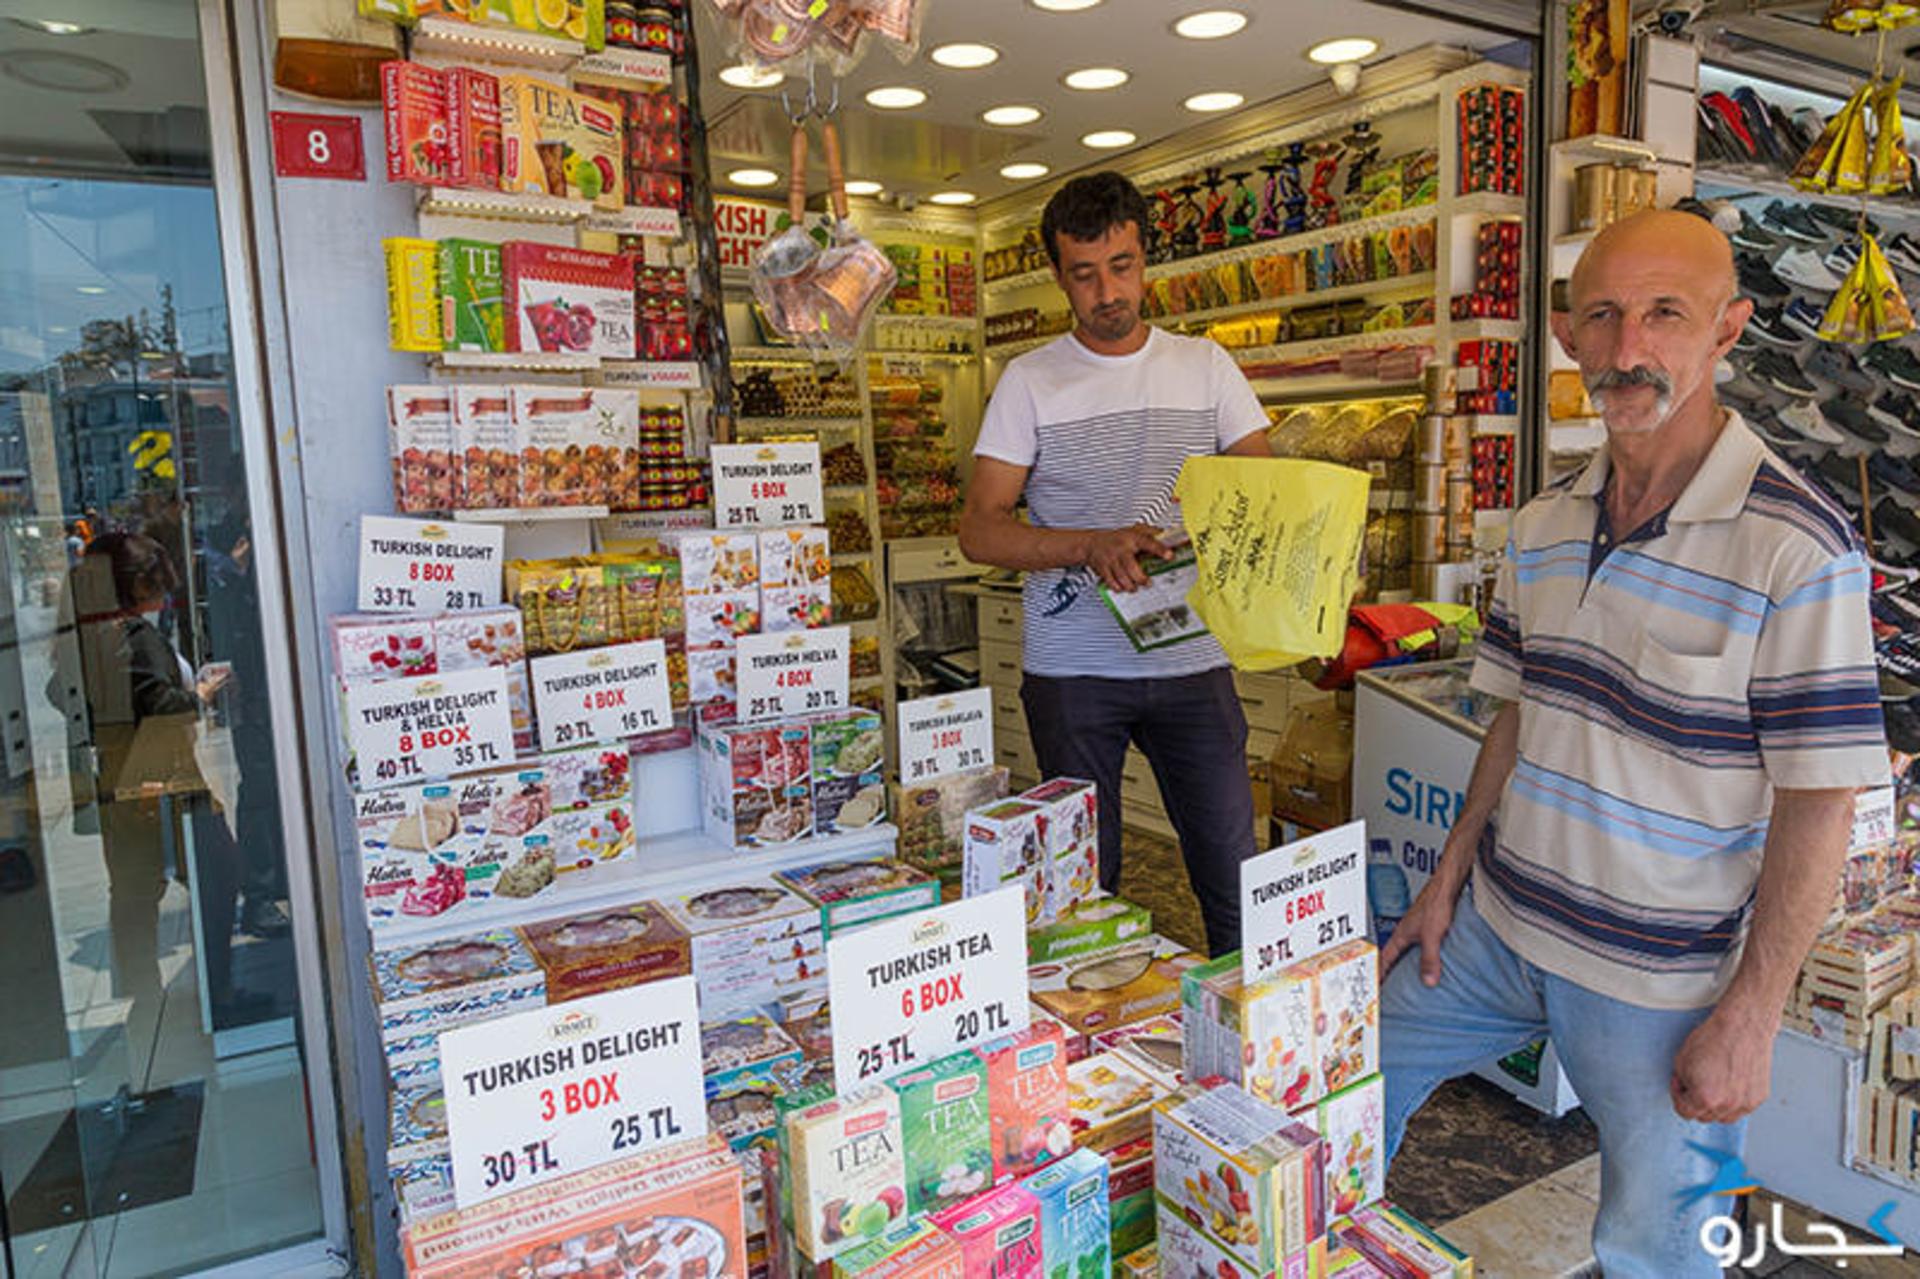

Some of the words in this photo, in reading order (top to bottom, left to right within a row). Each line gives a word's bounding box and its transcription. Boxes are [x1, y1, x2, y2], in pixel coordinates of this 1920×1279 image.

[527, 83, 580, 126] TEA
[308, 129, 331, 163] 8
[600, 320, 631, 339] TEA
[721, 465, 768, 478] TURKISH
[770, 462, 813, 476] DELIGHT
[762, 481, 787, 499] BOX
[745, 506, 760, 523] TL
[781, 505, 796, 521] 22
[798, 504, 813, 519] TL
[371, 539, 432, 557] TURKISH
[436, 544, 494, 560] DELIGHT
[409, 562, 419, 581] 8
[423, 563, 455, 582] BOX
[374, 587, 393, 606] 33
[397, 588, 416, 607] TL
[446, 590, 463, 609] 28
[467, 591, 483, 609] TL
[751, 652, 799, 669] TURKISH
[801, 648, 838, 664] HELVA
[544, 672, 601, 693] TURKISH
[604, 662, 658, 684] DELIGHT
[776, 671, 785, 688] 4
[787, 669, 812, 688] BOX
[361, 697, 431, 724] TURKISH
[434, 690, 498, 712] DELIGHT
[583, 694, 592, 710] 4
[595, 688, 626, 710] BOX
[750, 698, 765, 716] 25
[768, 696, 783, 713] TL
[806, 691, 821, 709] 20
[823, 690, 838, 706] TL
[399, 735, 413, 753] 8
[421, 725, 472, 749] BOX
[400, 718, 412, 733] &
[416, 711, 467, 730] HELVA
[554, 723, 572, 743] 20
[575, 721, 594, 739] TL
[641, 709, 659, 727] TL
[376, 758, 397, 780] 40
[400, 755, 423, 776] TL
[454, 745, 475, 767] 35
[478, 742, 499, 762] TL
[360, 799, 406, 816] Halva
[367, 866, 413, 884] Halva
[1403, 840, 1442, 876] Col
[1252, 871, 1305, 905] TURKISH
[1307, 852, 1357, 885] DELIGHT
[1285, 901, 1294, 925] 6
[1297, 889, 1326, 920] BOX
[1277, 937, 1294, 961] TL
[1317, 920, 1335, 945] 25
[1337, 913, 1354, 937] TL
[867, 944, 951, 990] TURKISH
[956, 932, 993, 960] TEA
[902, 988, 915, 1018] 6
[920, 973, 964, 1013] BOX
[857, 1044, 883, 1079] 25
[888, 1034, 915, 1066] TL
[955, 1011, 979, 1043] 20
[984, 1002, 1010, 1032] TL
[463, 1047, 575, 1097] TURKISH
[582, 1021, 683, 1066] DELIGHT
[539, 1088, 556, 1122] 3
[563, 1072, 620, 1115] BOX
[923, 1096, 982, 1136] TEA
[483, 1150, 516, 1189] 30
[522, 1140, 559, 1175] TL
[611, 1114, 642, 1151] 25
[648, 1106, 682, 1139] TL
[829, 1131, 893, 1173] TEA
